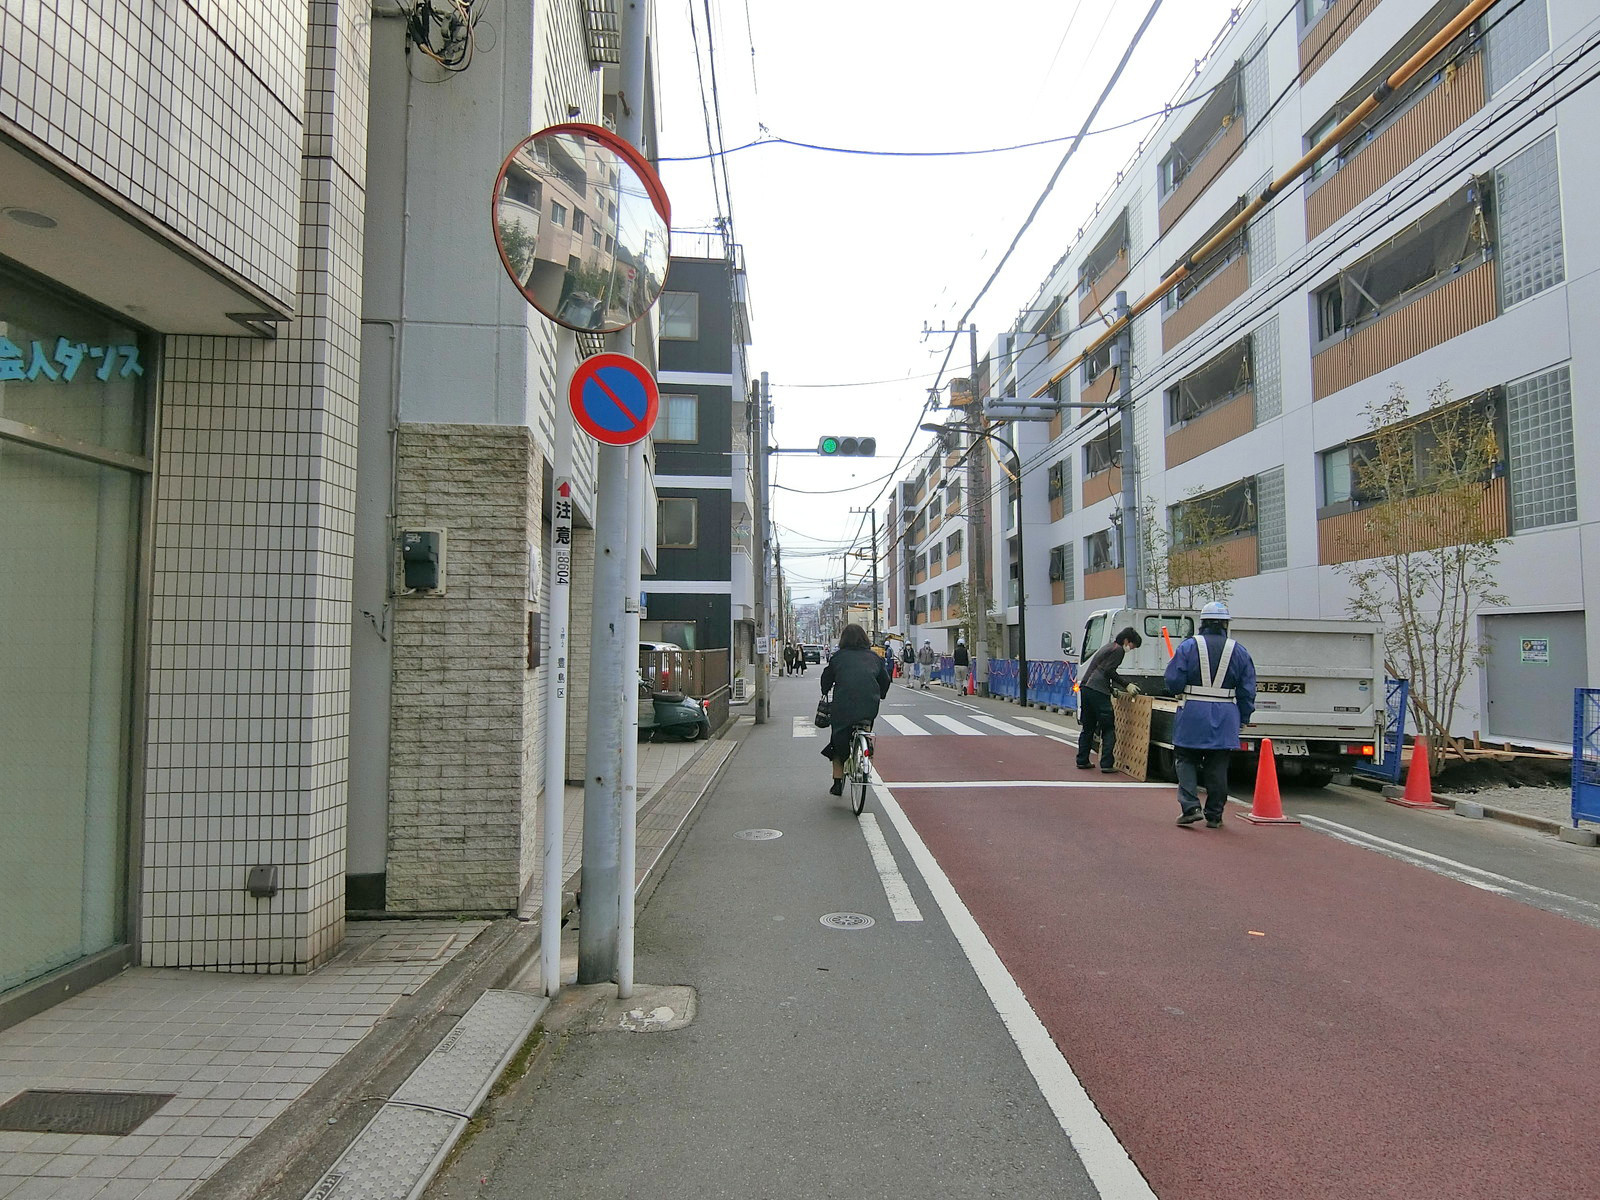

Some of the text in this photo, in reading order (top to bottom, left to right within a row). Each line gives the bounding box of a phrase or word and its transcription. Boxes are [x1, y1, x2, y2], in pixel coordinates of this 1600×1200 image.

[556, 501, 571, 545] 注意
[557, 556, 570, 585] 8604
[557, 657, 565, 698] 豊島区
[1256, 682, 1303, 693] 高圧ガス
